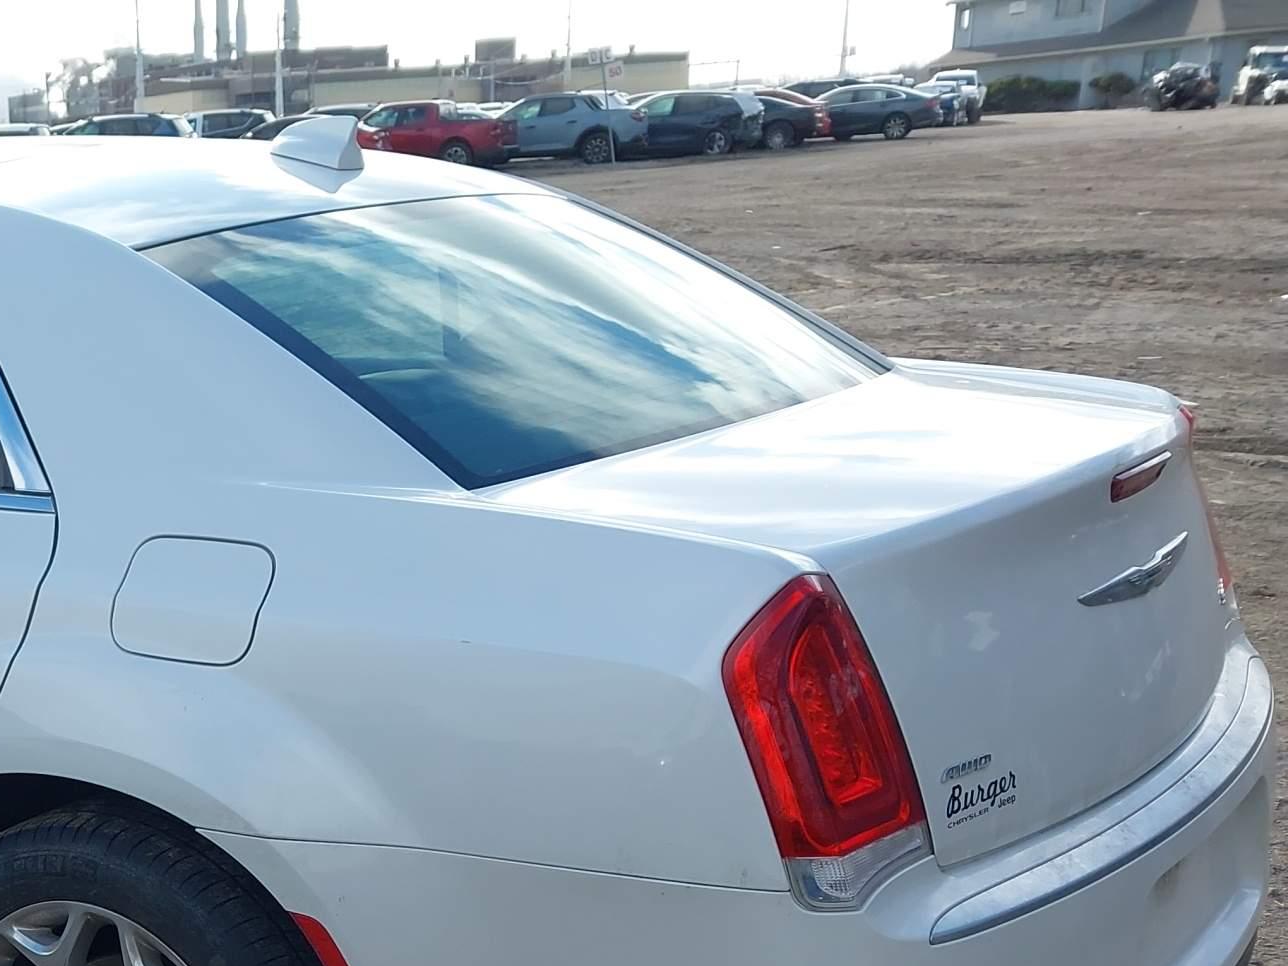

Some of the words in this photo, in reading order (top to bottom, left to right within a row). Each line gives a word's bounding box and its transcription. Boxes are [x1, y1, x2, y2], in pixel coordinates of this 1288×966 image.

[946, 771, 1016, 818] Burger
[997, 794, 1016, 808] Jeep
[947, 807, 989, 828] CHRYSLER
